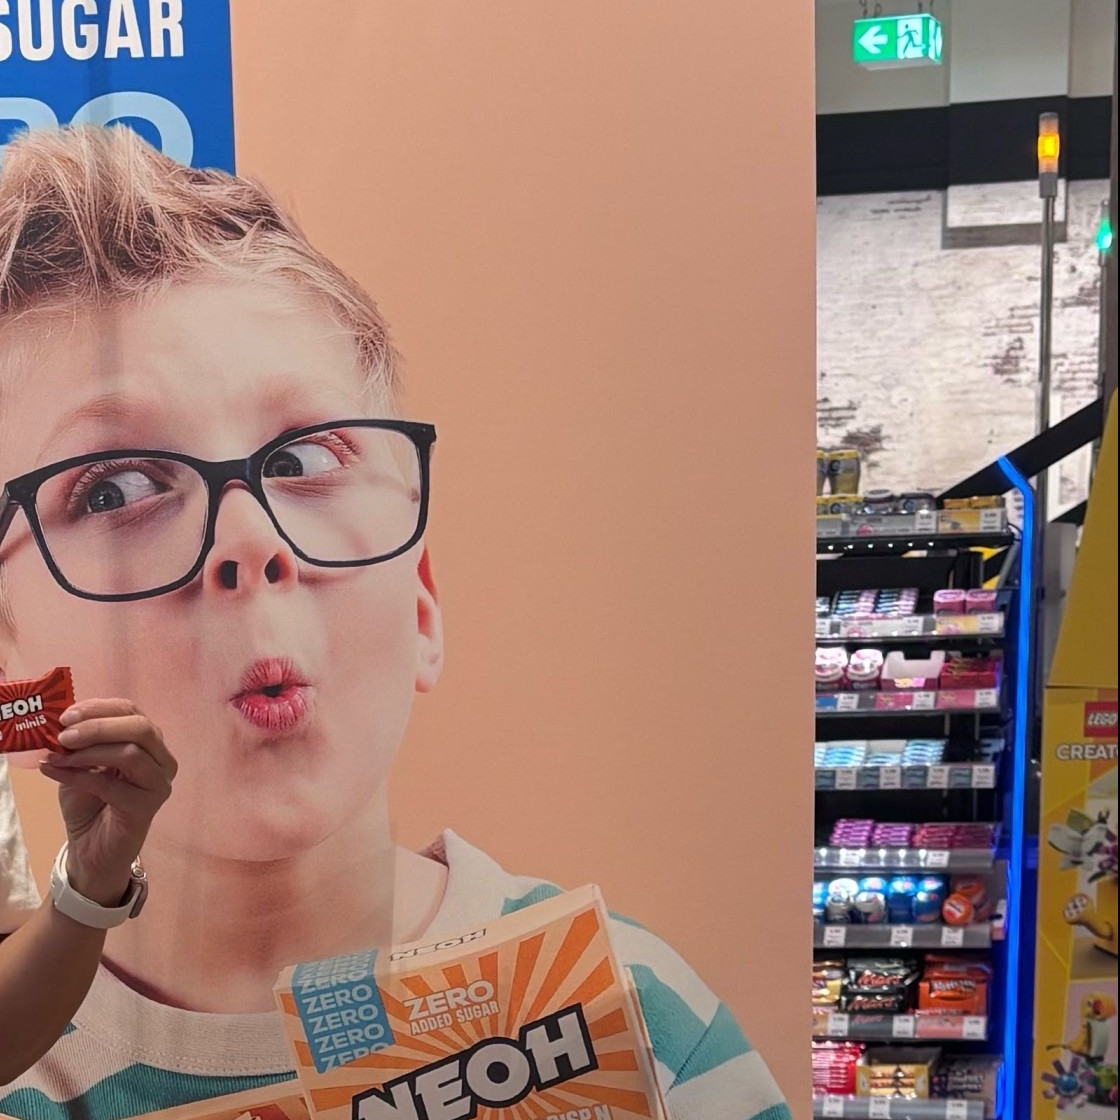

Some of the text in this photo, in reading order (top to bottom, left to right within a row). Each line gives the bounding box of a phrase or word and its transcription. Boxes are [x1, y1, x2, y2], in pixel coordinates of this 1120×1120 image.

[15, 714, 47, 732] minis
[1056, 744, 1118, 760] CREAT
[302, 984, 373, 1014] ZERO
[403, 979, 495, 1022] ZERO
[308, 1003, 379, 1034] ZERO
[410, 1000, 501, 1037] ADDED SUGAR
[314, 1023, 385, 1054] ZERO
